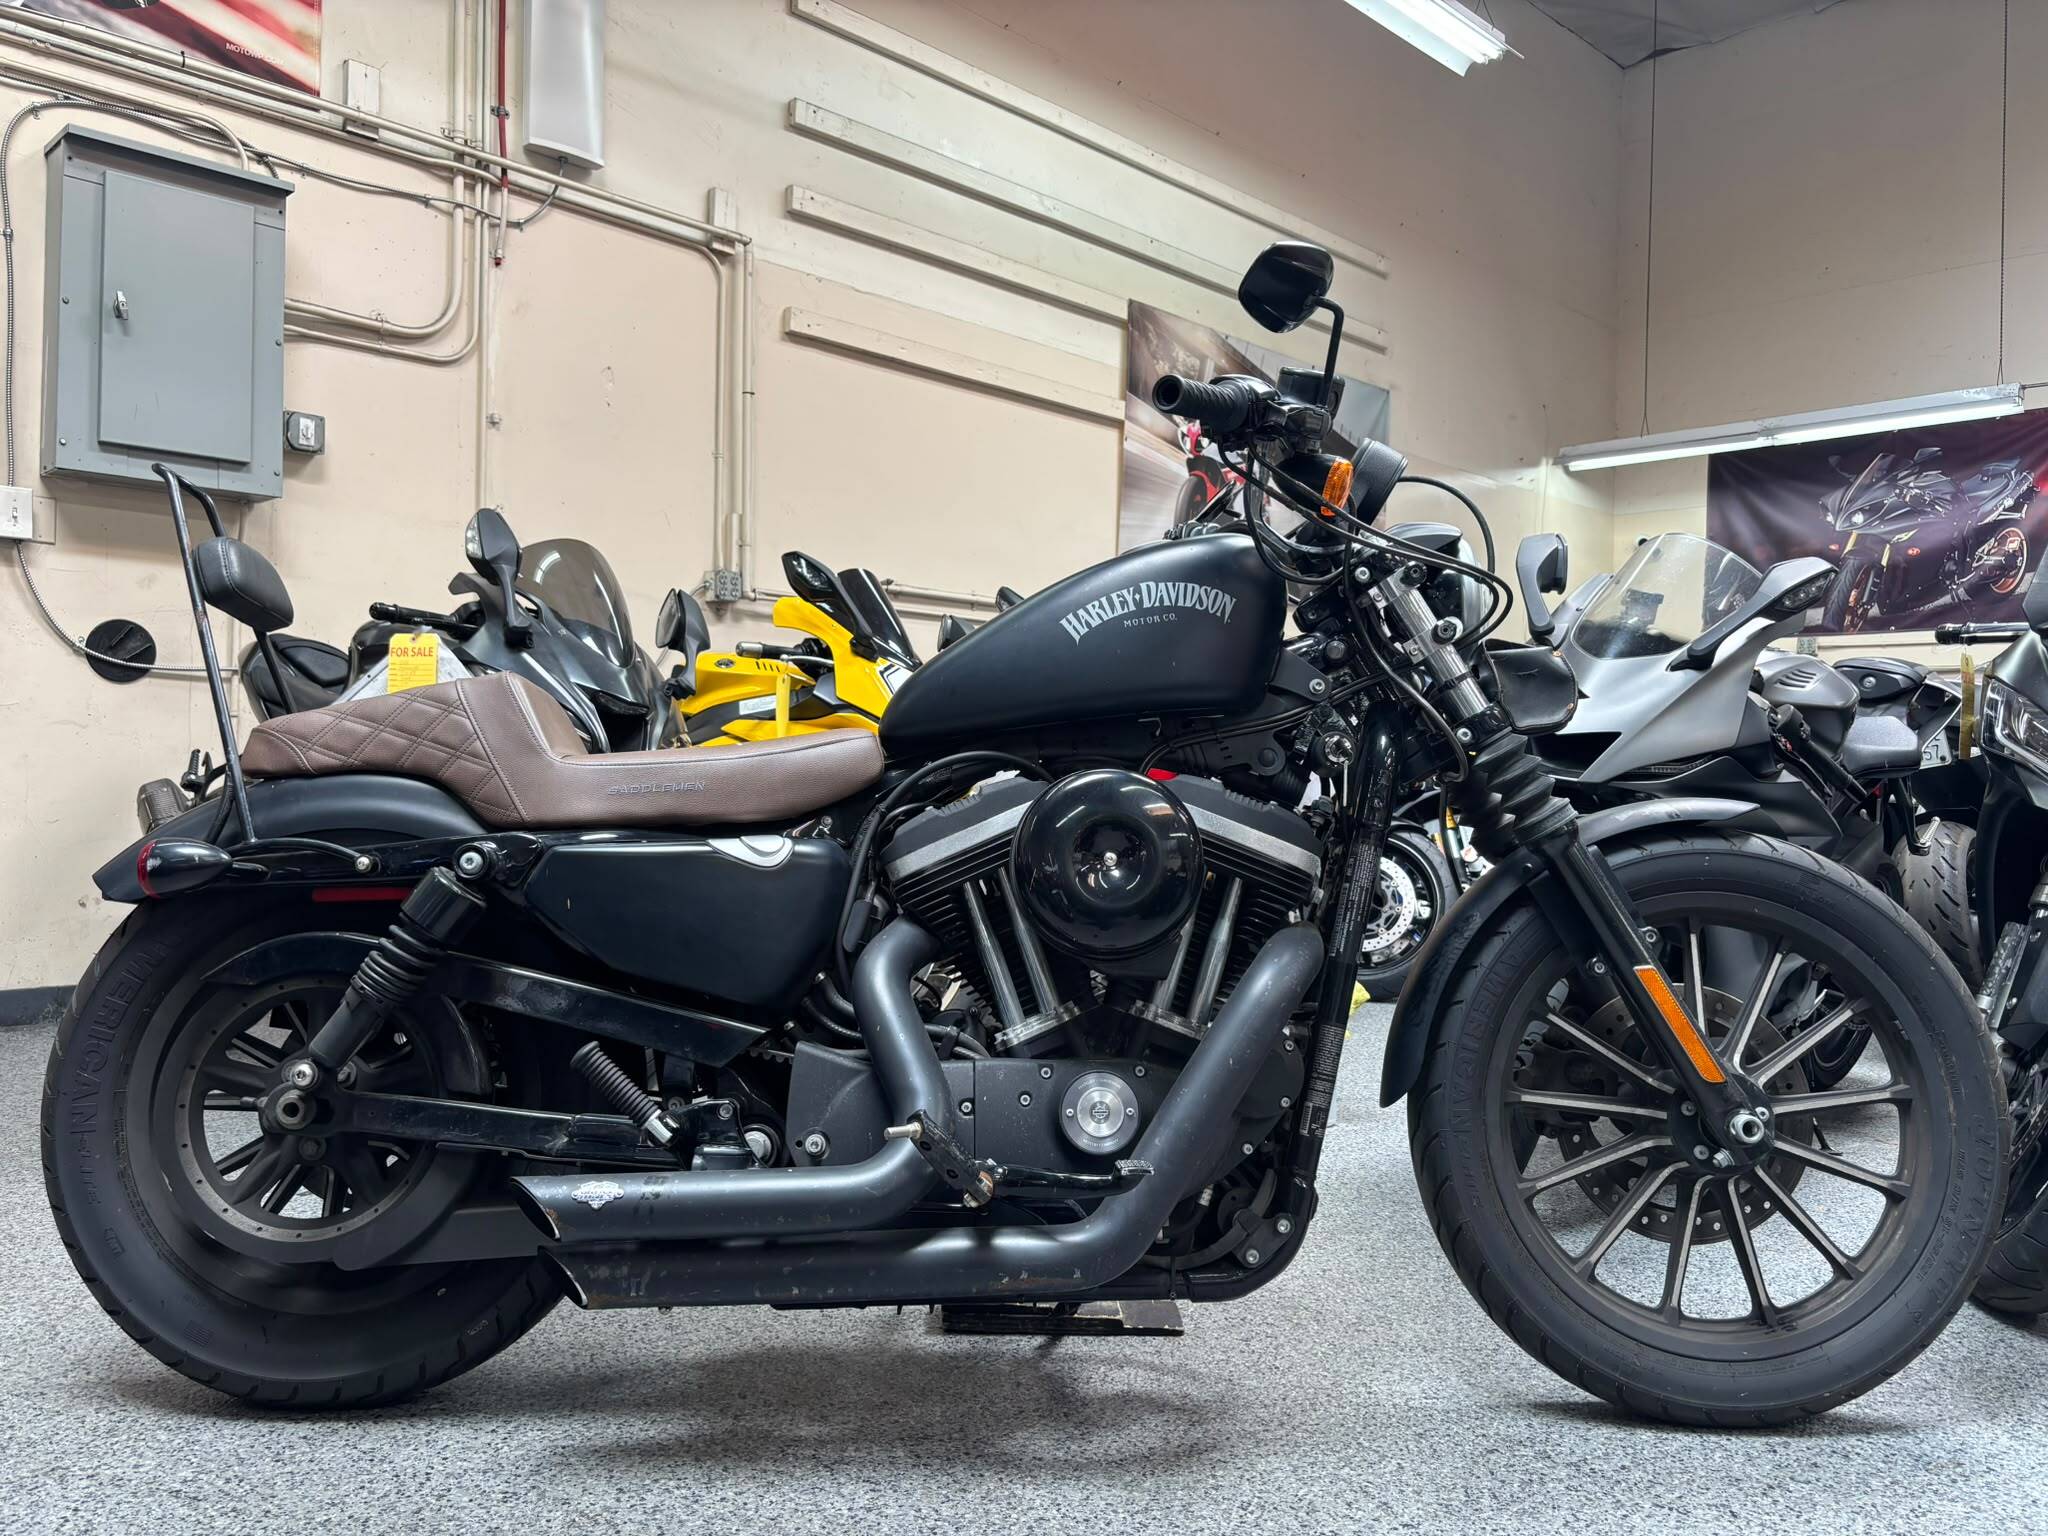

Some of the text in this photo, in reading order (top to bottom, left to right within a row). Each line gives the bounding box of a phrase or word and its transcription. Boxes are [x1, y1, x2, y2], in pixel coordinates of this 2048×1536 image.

[1123, 615, 1161, 628] MOTOR
[390, 646, 434, 658] FOR SALE
[607, 781, 705, 796] SADDLEMEN
